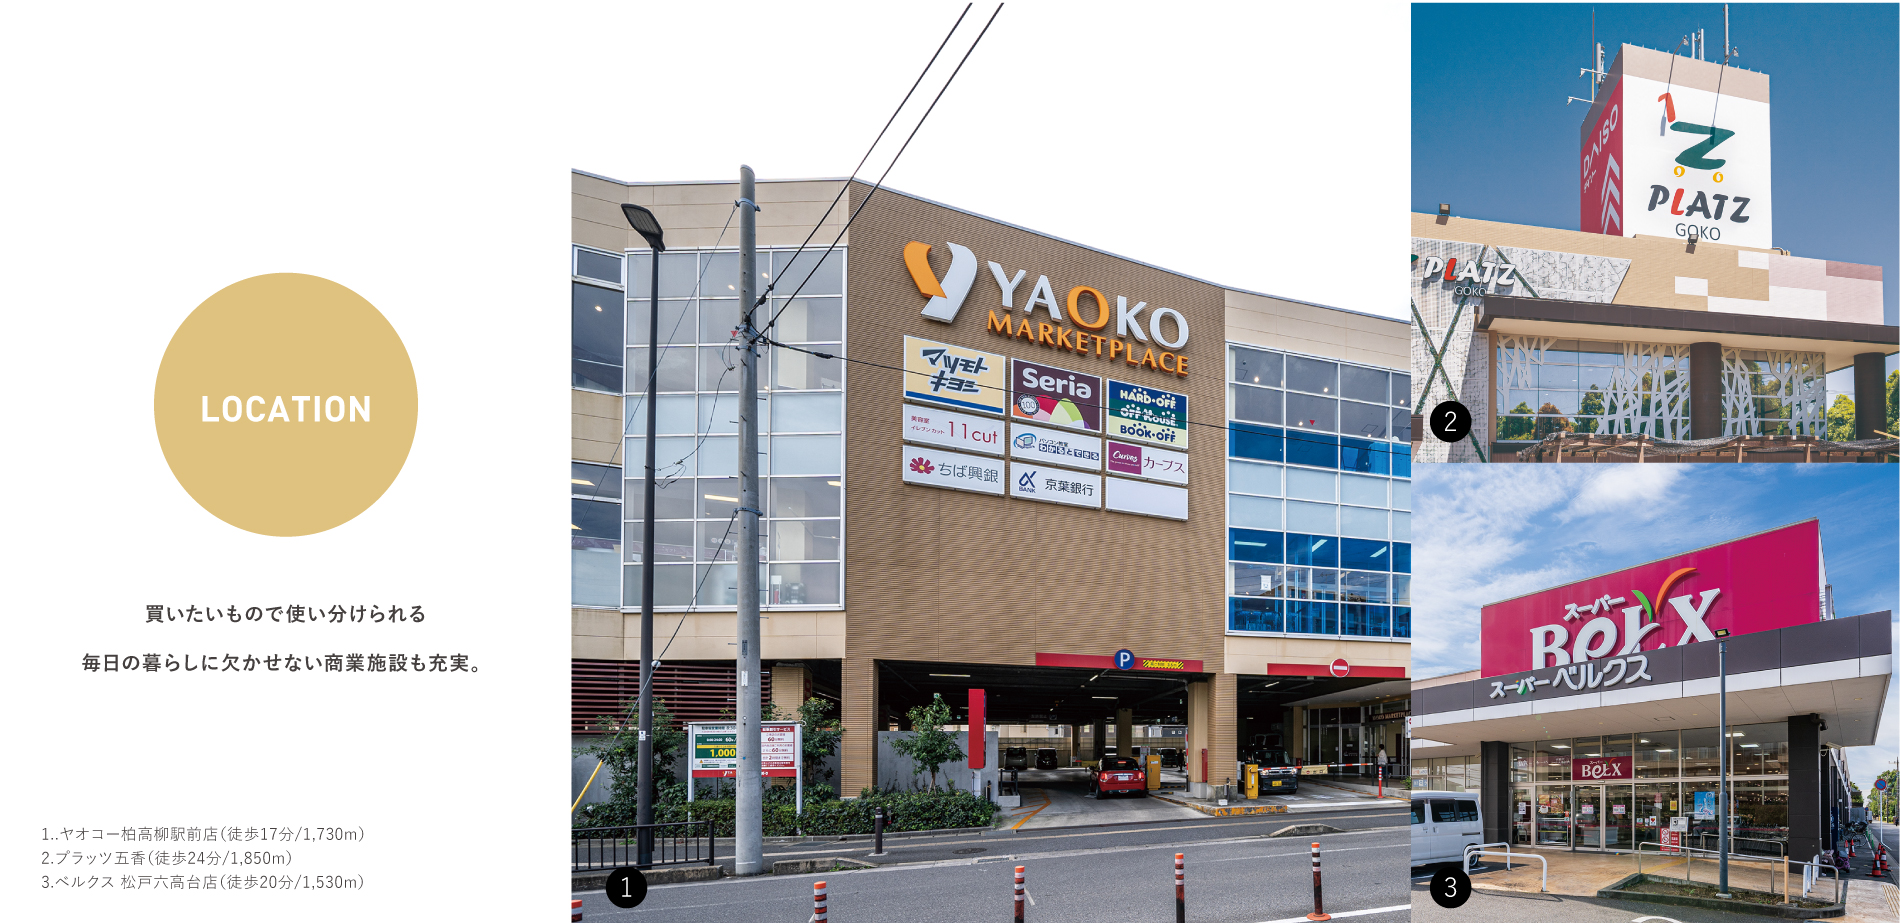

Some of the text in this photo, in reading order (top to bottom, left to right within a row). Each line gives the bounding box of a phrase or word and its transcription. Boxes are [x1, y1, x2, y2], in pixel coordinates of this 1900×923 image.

[1583, 103, 1619, 179] DAISO
[1647, 184, 1751, 223] PLATZ
[1675, 223, 1721, 241] GOKO
[1423, 256, 1516, 286] PLATZ
[1454, 286, 1487, 297] GOKO
[987, 260, 1190, 351] YAOKO
[987, 309, 1190, 377] MARKETPLACE
[922, 347, 989, 374] マツモト
[930, 370, 981, 394] キヨシ
[1022, 367, 1092, 399] Seria
[1038, 443, 1100, 461] わかるとできる
[1112, 450, 1138, 463] Curves
[938, 462, 999, 483] ちば興銀
[1018, 486, 1036, 494] BANK
[1045, 478, 1094, 497] 京葉銀行
[1563, 593, 1626, 621] スーパー
[1120, 652, 1131, 667] P
[710, 749, 736, 758] 1,000
